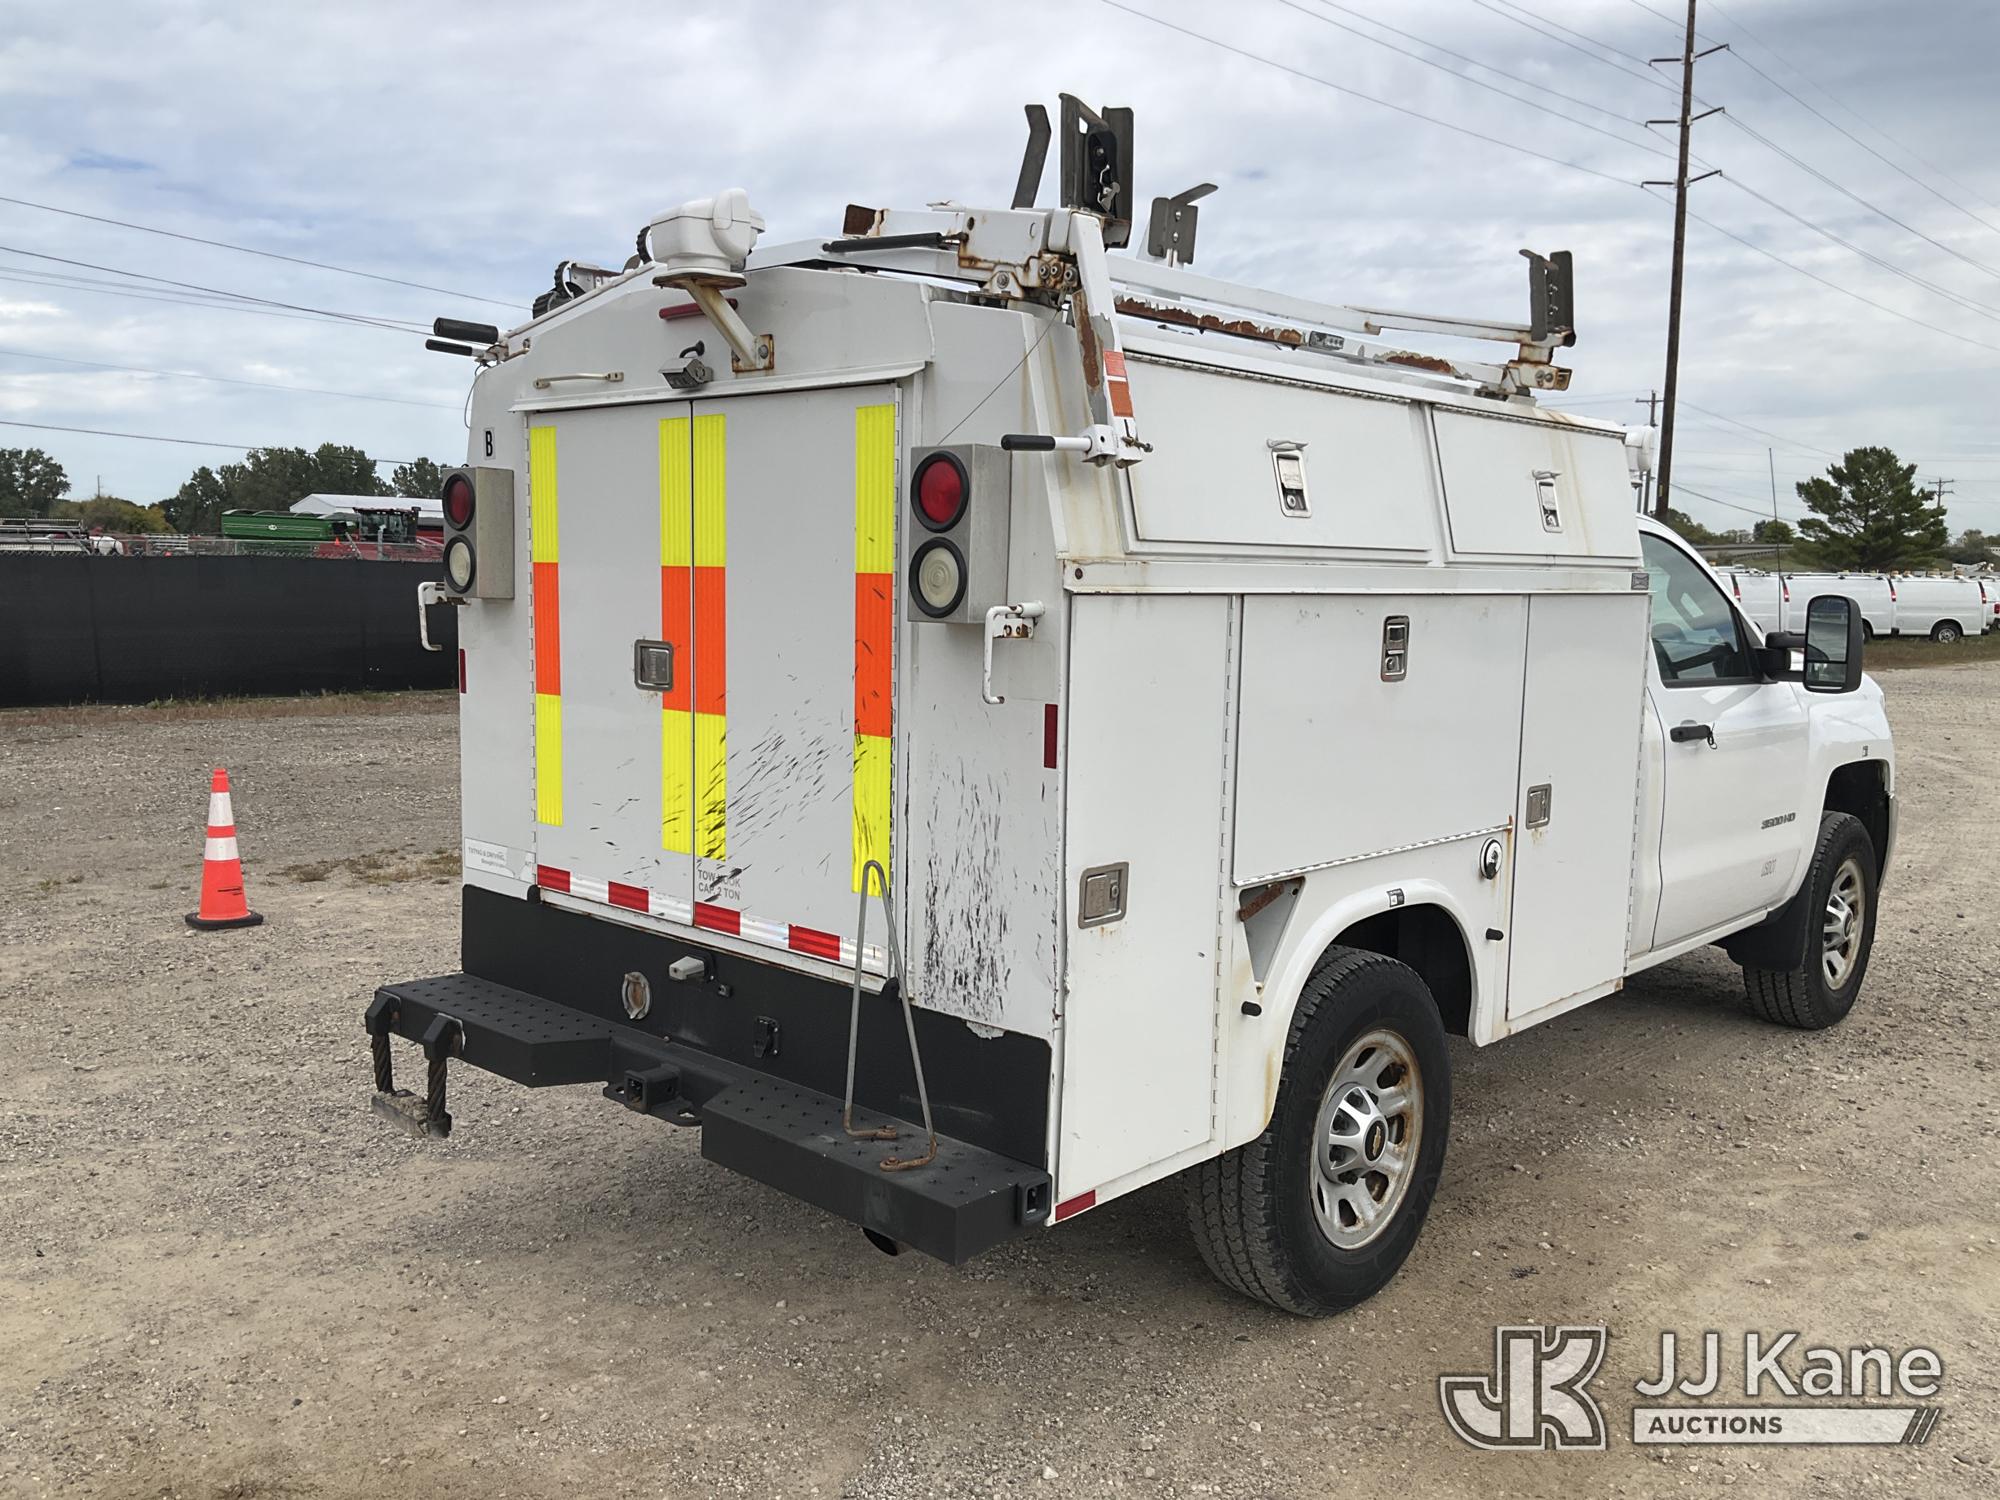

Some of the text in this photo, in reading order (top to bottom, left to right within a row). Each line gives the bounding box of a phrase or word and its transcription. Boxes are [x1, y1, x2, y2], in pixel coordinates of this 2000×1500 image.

[485, 430, 493, 457] B
[697, 869, 715, 882] TOW
[723, 887, 740, 901] TON
